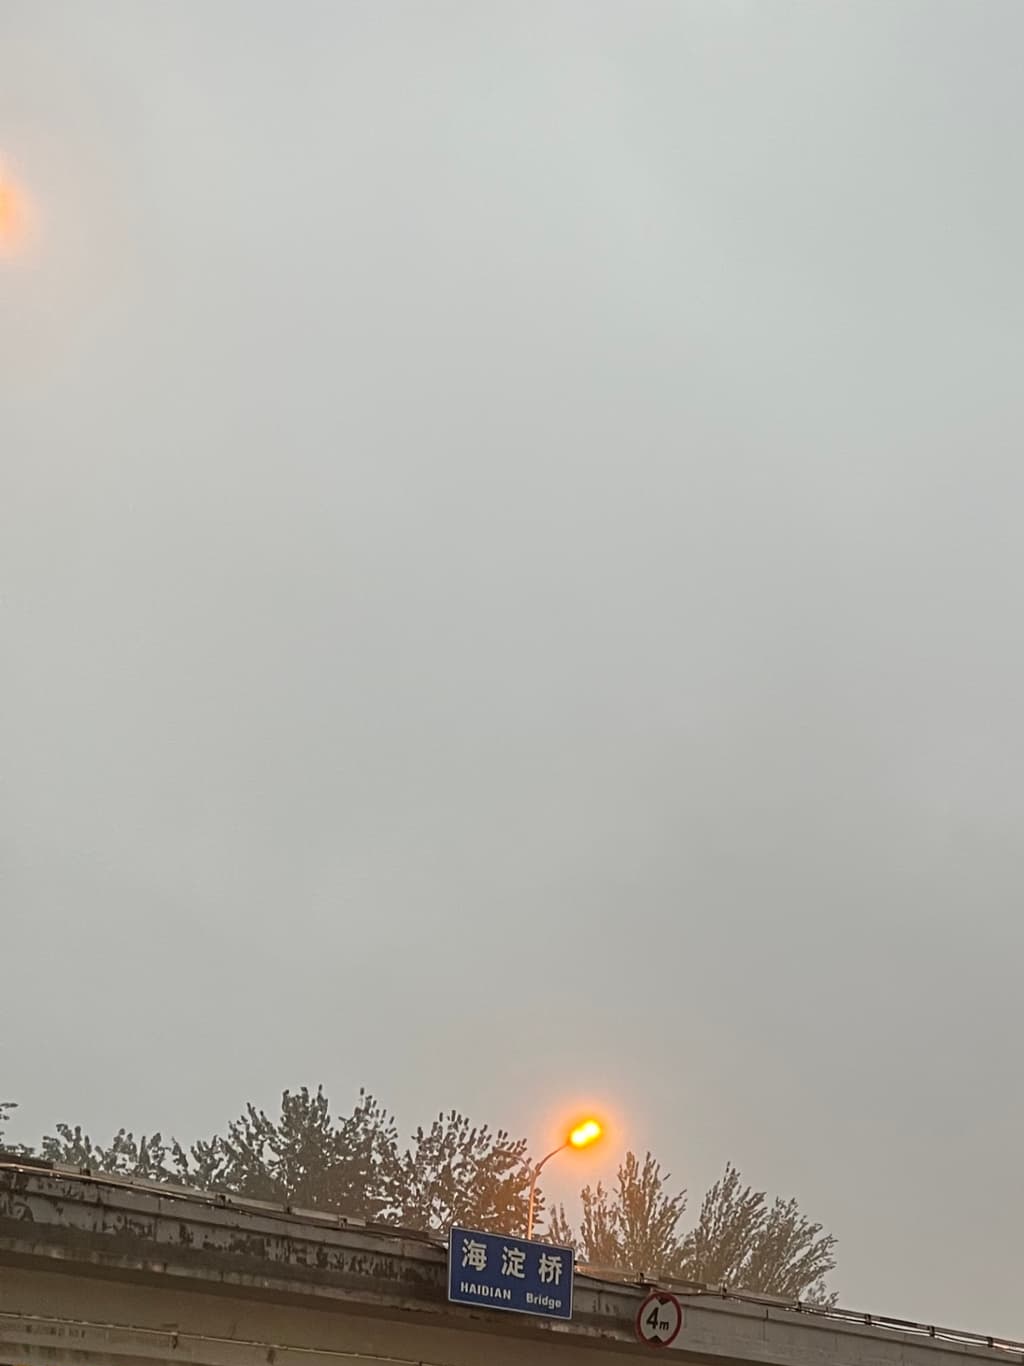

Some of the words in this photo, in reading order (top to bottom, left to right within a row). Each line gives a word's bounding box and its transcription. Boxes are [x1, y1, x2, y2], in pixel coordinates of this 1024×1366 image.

[462, 1238, 563, 1286] 海淀桥
[460, 1281, 511, 1300] HAIDIAN
[526, 1292, 562, 1309] Bridge
